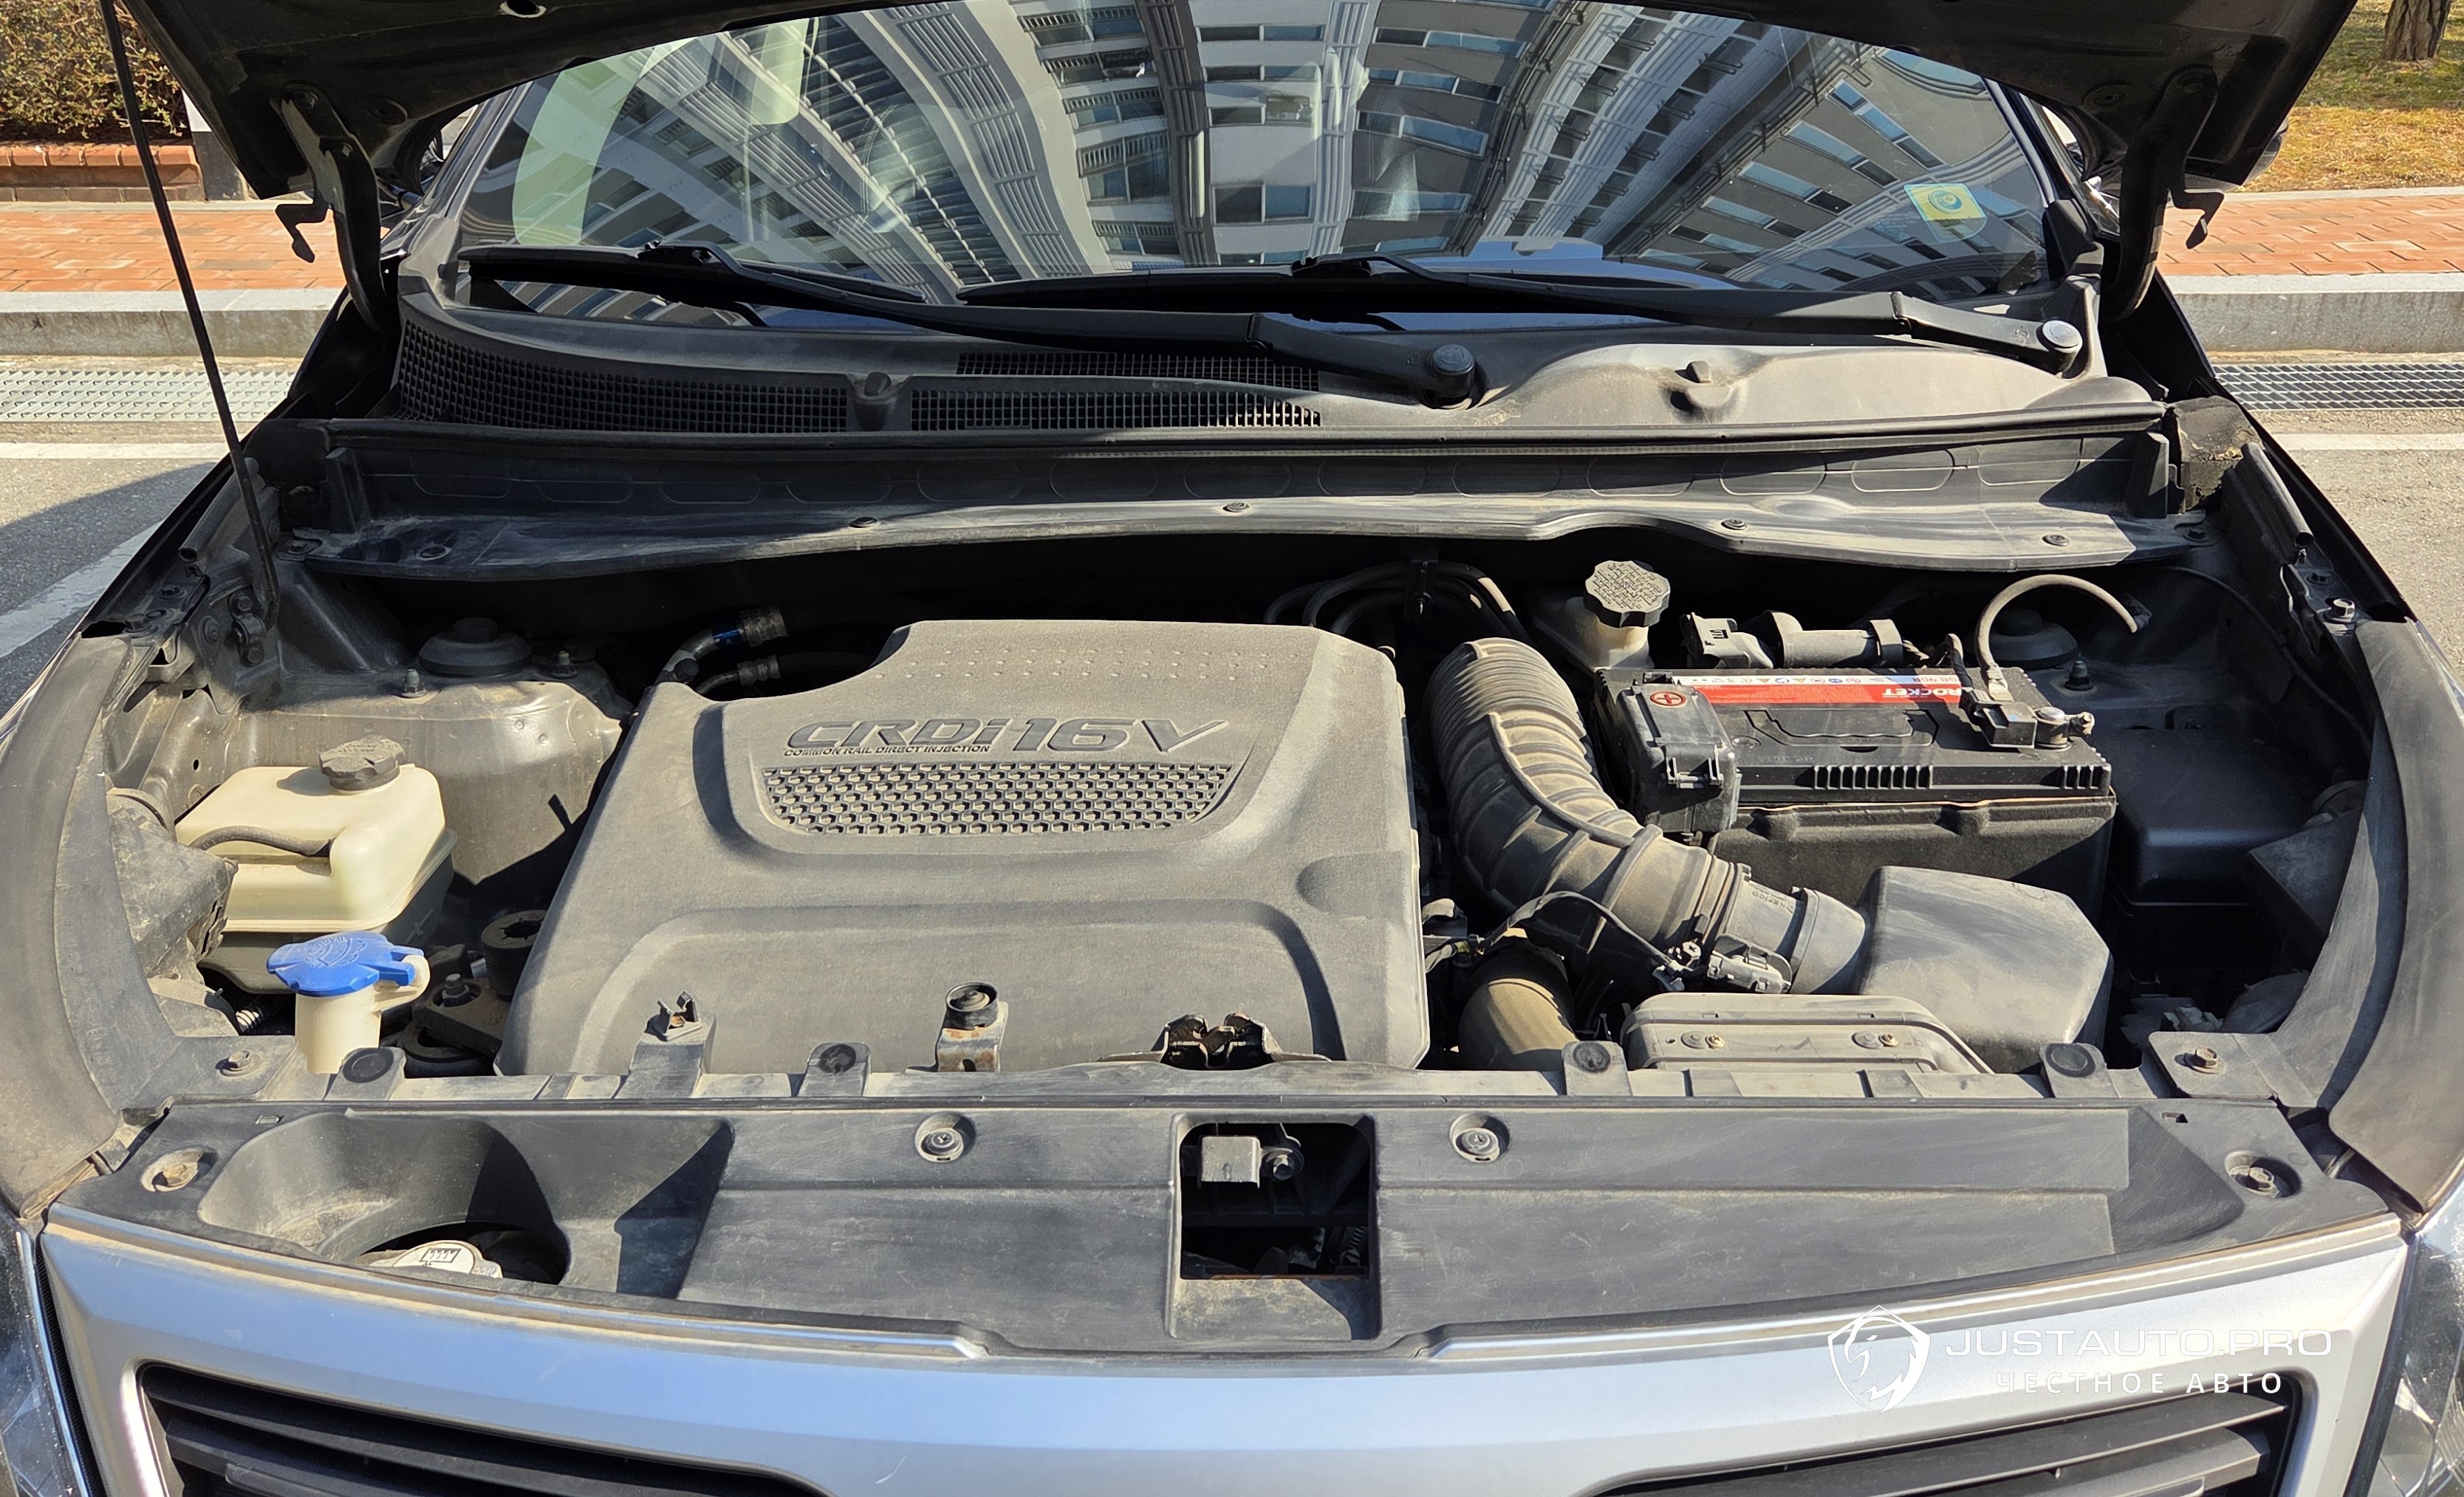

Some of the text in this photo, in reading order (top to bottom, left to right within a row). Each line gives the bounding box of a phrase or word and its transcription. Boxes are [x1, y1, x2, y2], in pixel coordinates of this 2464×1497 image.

[1882, 688, 1962, 696] ROCKET
[787, 718, 1013, 749] CRDi
[784, 748, 840, 756] COMMON
[843, 747, 872, 755] RAIL
[923, 744, 990, 753] INJECTION
